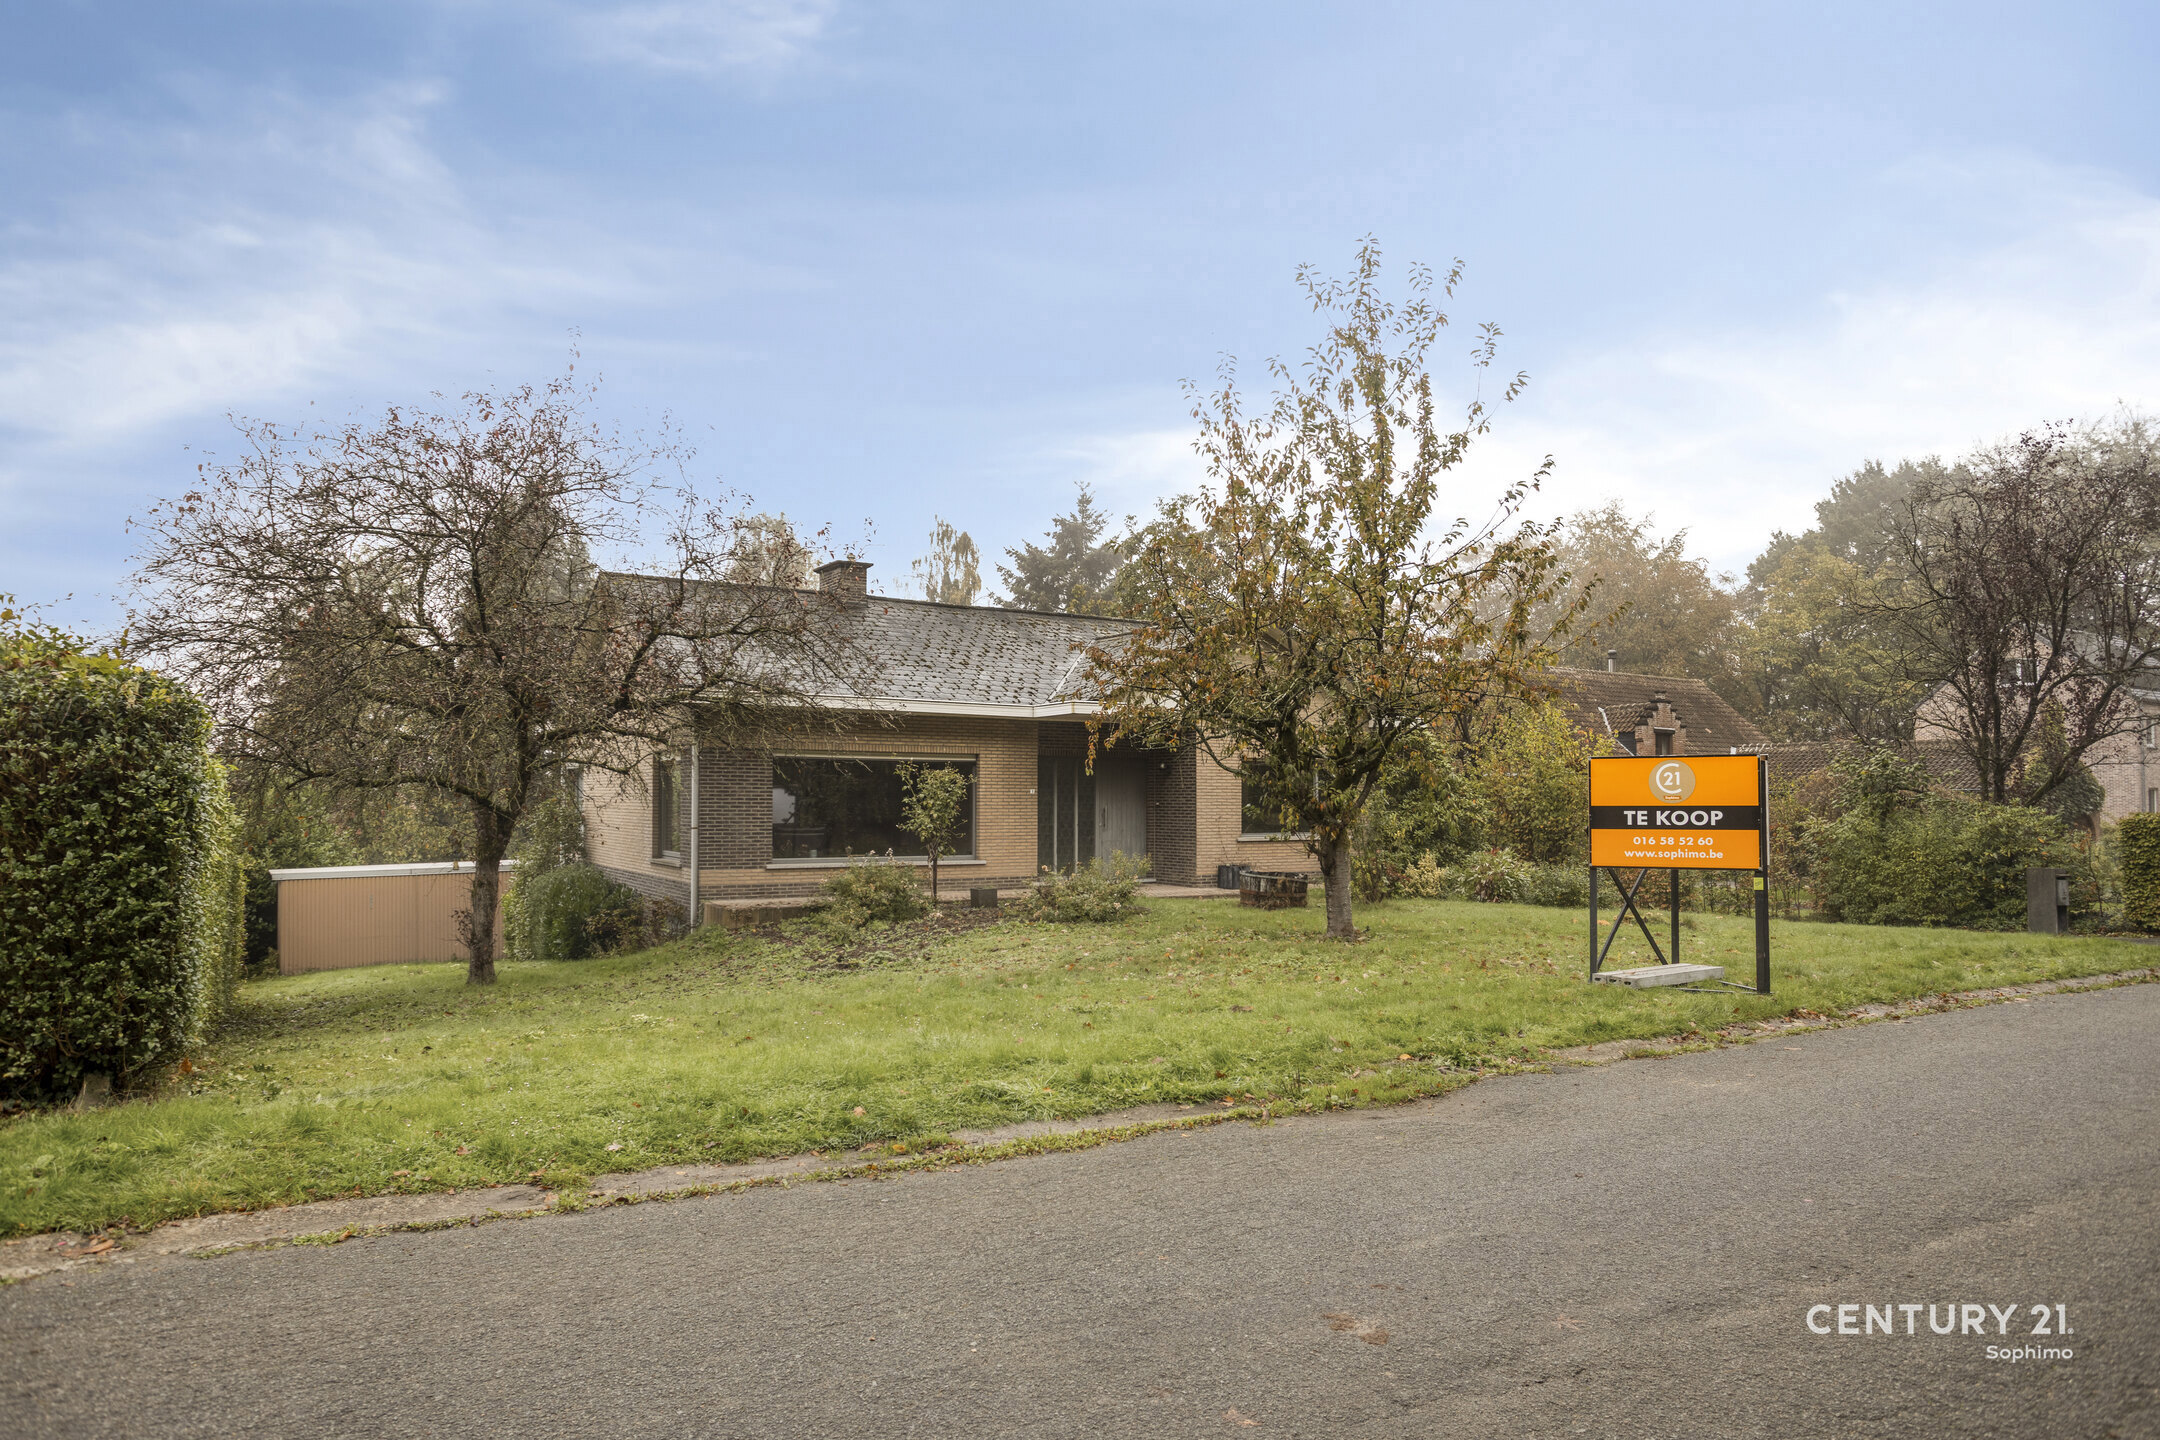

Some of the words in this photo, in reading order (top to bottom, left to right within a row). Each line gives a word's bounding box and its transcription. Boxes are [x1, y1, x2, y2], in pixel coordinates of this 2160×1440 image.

[1623, 810, 1648, 826] TE
[1656, 810, 1723, 826] KOOP
[1633, 836, 1656, 845] 016
[1659, 836, 1674, 845] 58
[1679, 836, 1694, 846] 52
[1697, 836, 1713, 846] 60
[1624, 849, 1724, 860] www.sophimo.be
